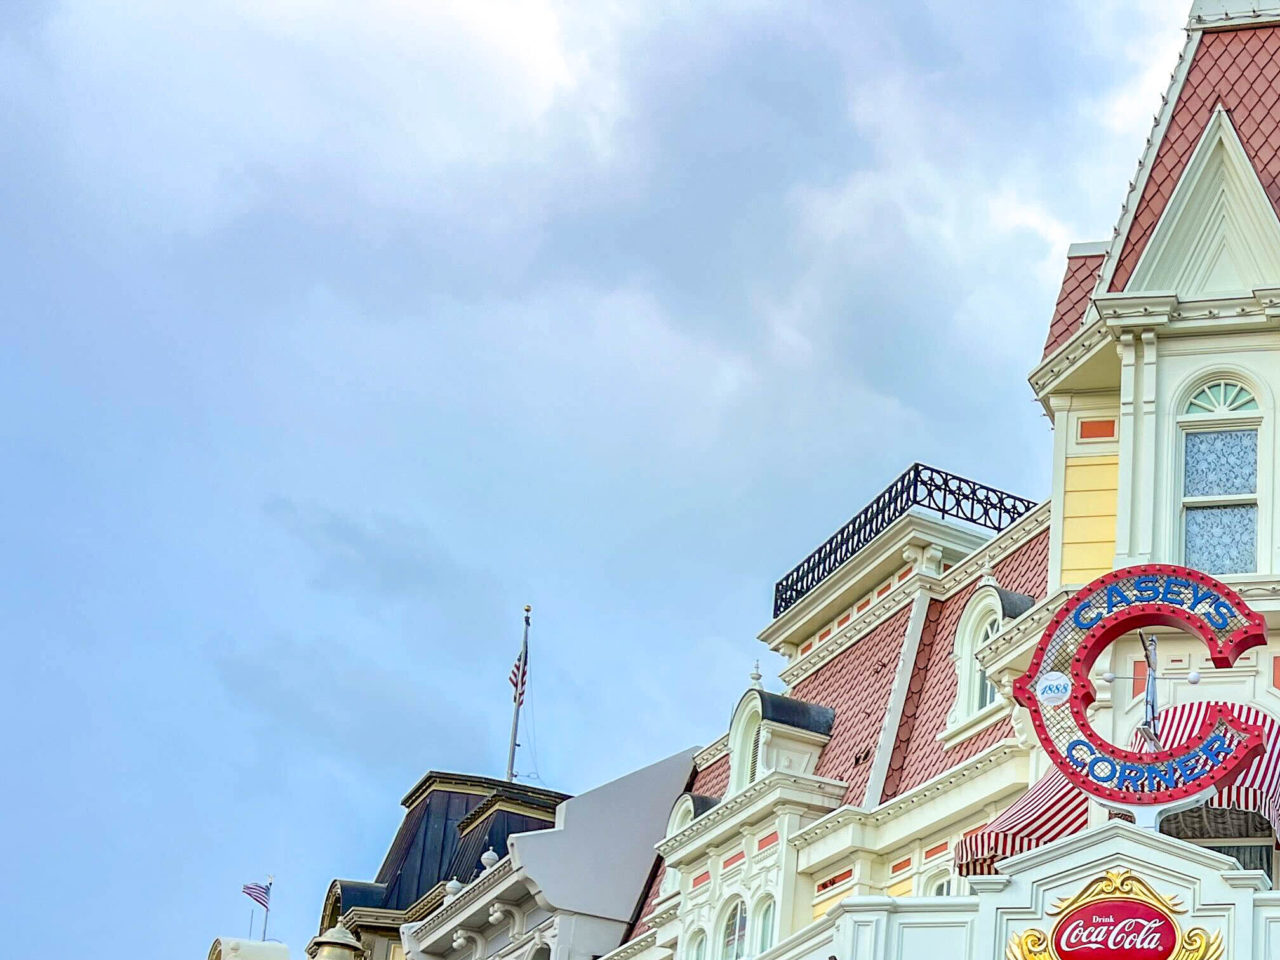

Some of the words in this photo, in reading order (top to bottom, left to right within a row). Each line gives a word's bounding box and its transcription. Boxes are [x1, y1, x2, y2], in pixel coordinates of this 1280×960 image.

[1072, 575, 1236, 630] CASEY'S
[1041, 683, 1069, 696] 1888
[1066, 734, 1233, 791] CORNER
[1060, 918, 1165, 951] Coca-Cola
[1092, 915, 1115, 923] Drink
